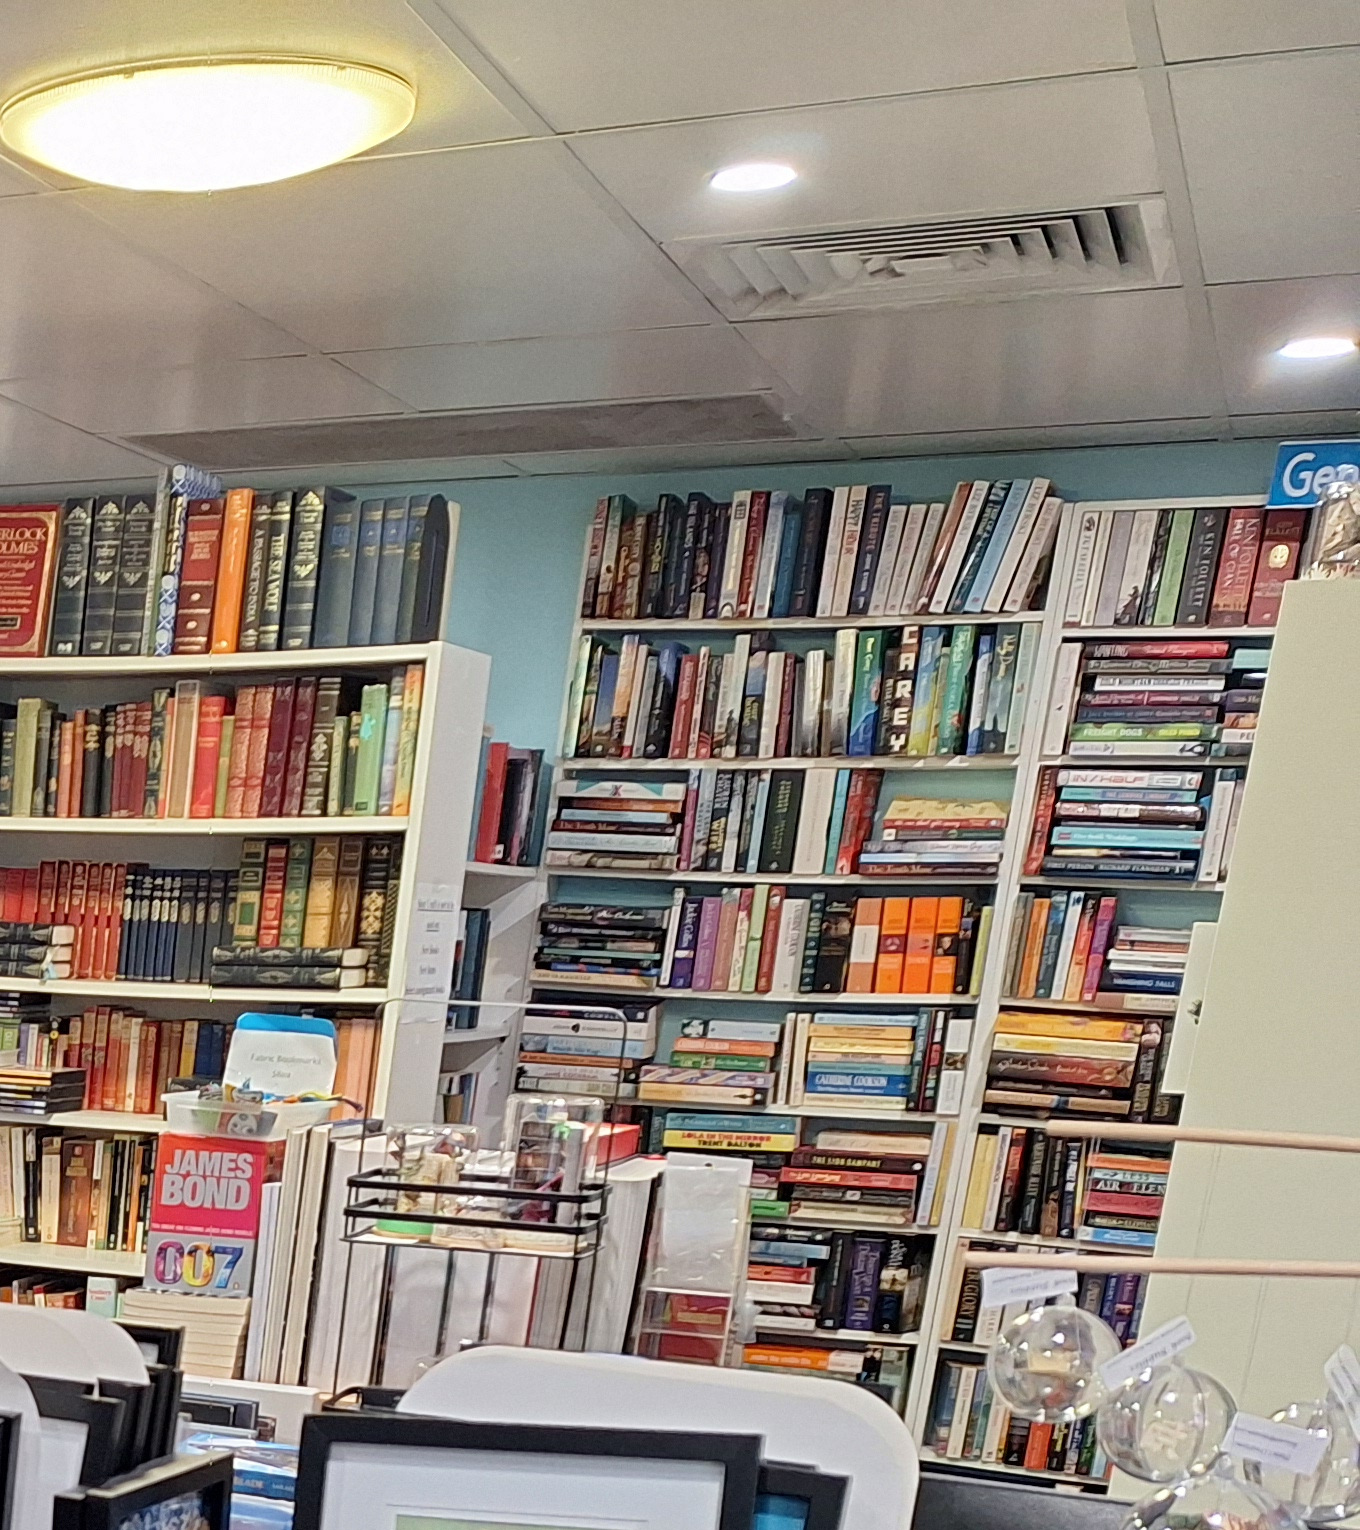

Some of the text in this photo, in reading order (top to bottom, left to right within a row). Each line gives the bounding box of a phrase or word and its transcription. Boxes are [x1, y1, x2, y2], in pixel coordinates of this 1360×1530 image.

[889, 626, 919, 752] CAREY
[681, 1131, 771, 1143] LOLA IN THE MIRROR
[165, 1149, 253, 1177] JAMES
[161, 1174, 249, 1210] BOND
[153, 1240, 243, 1287] 007
